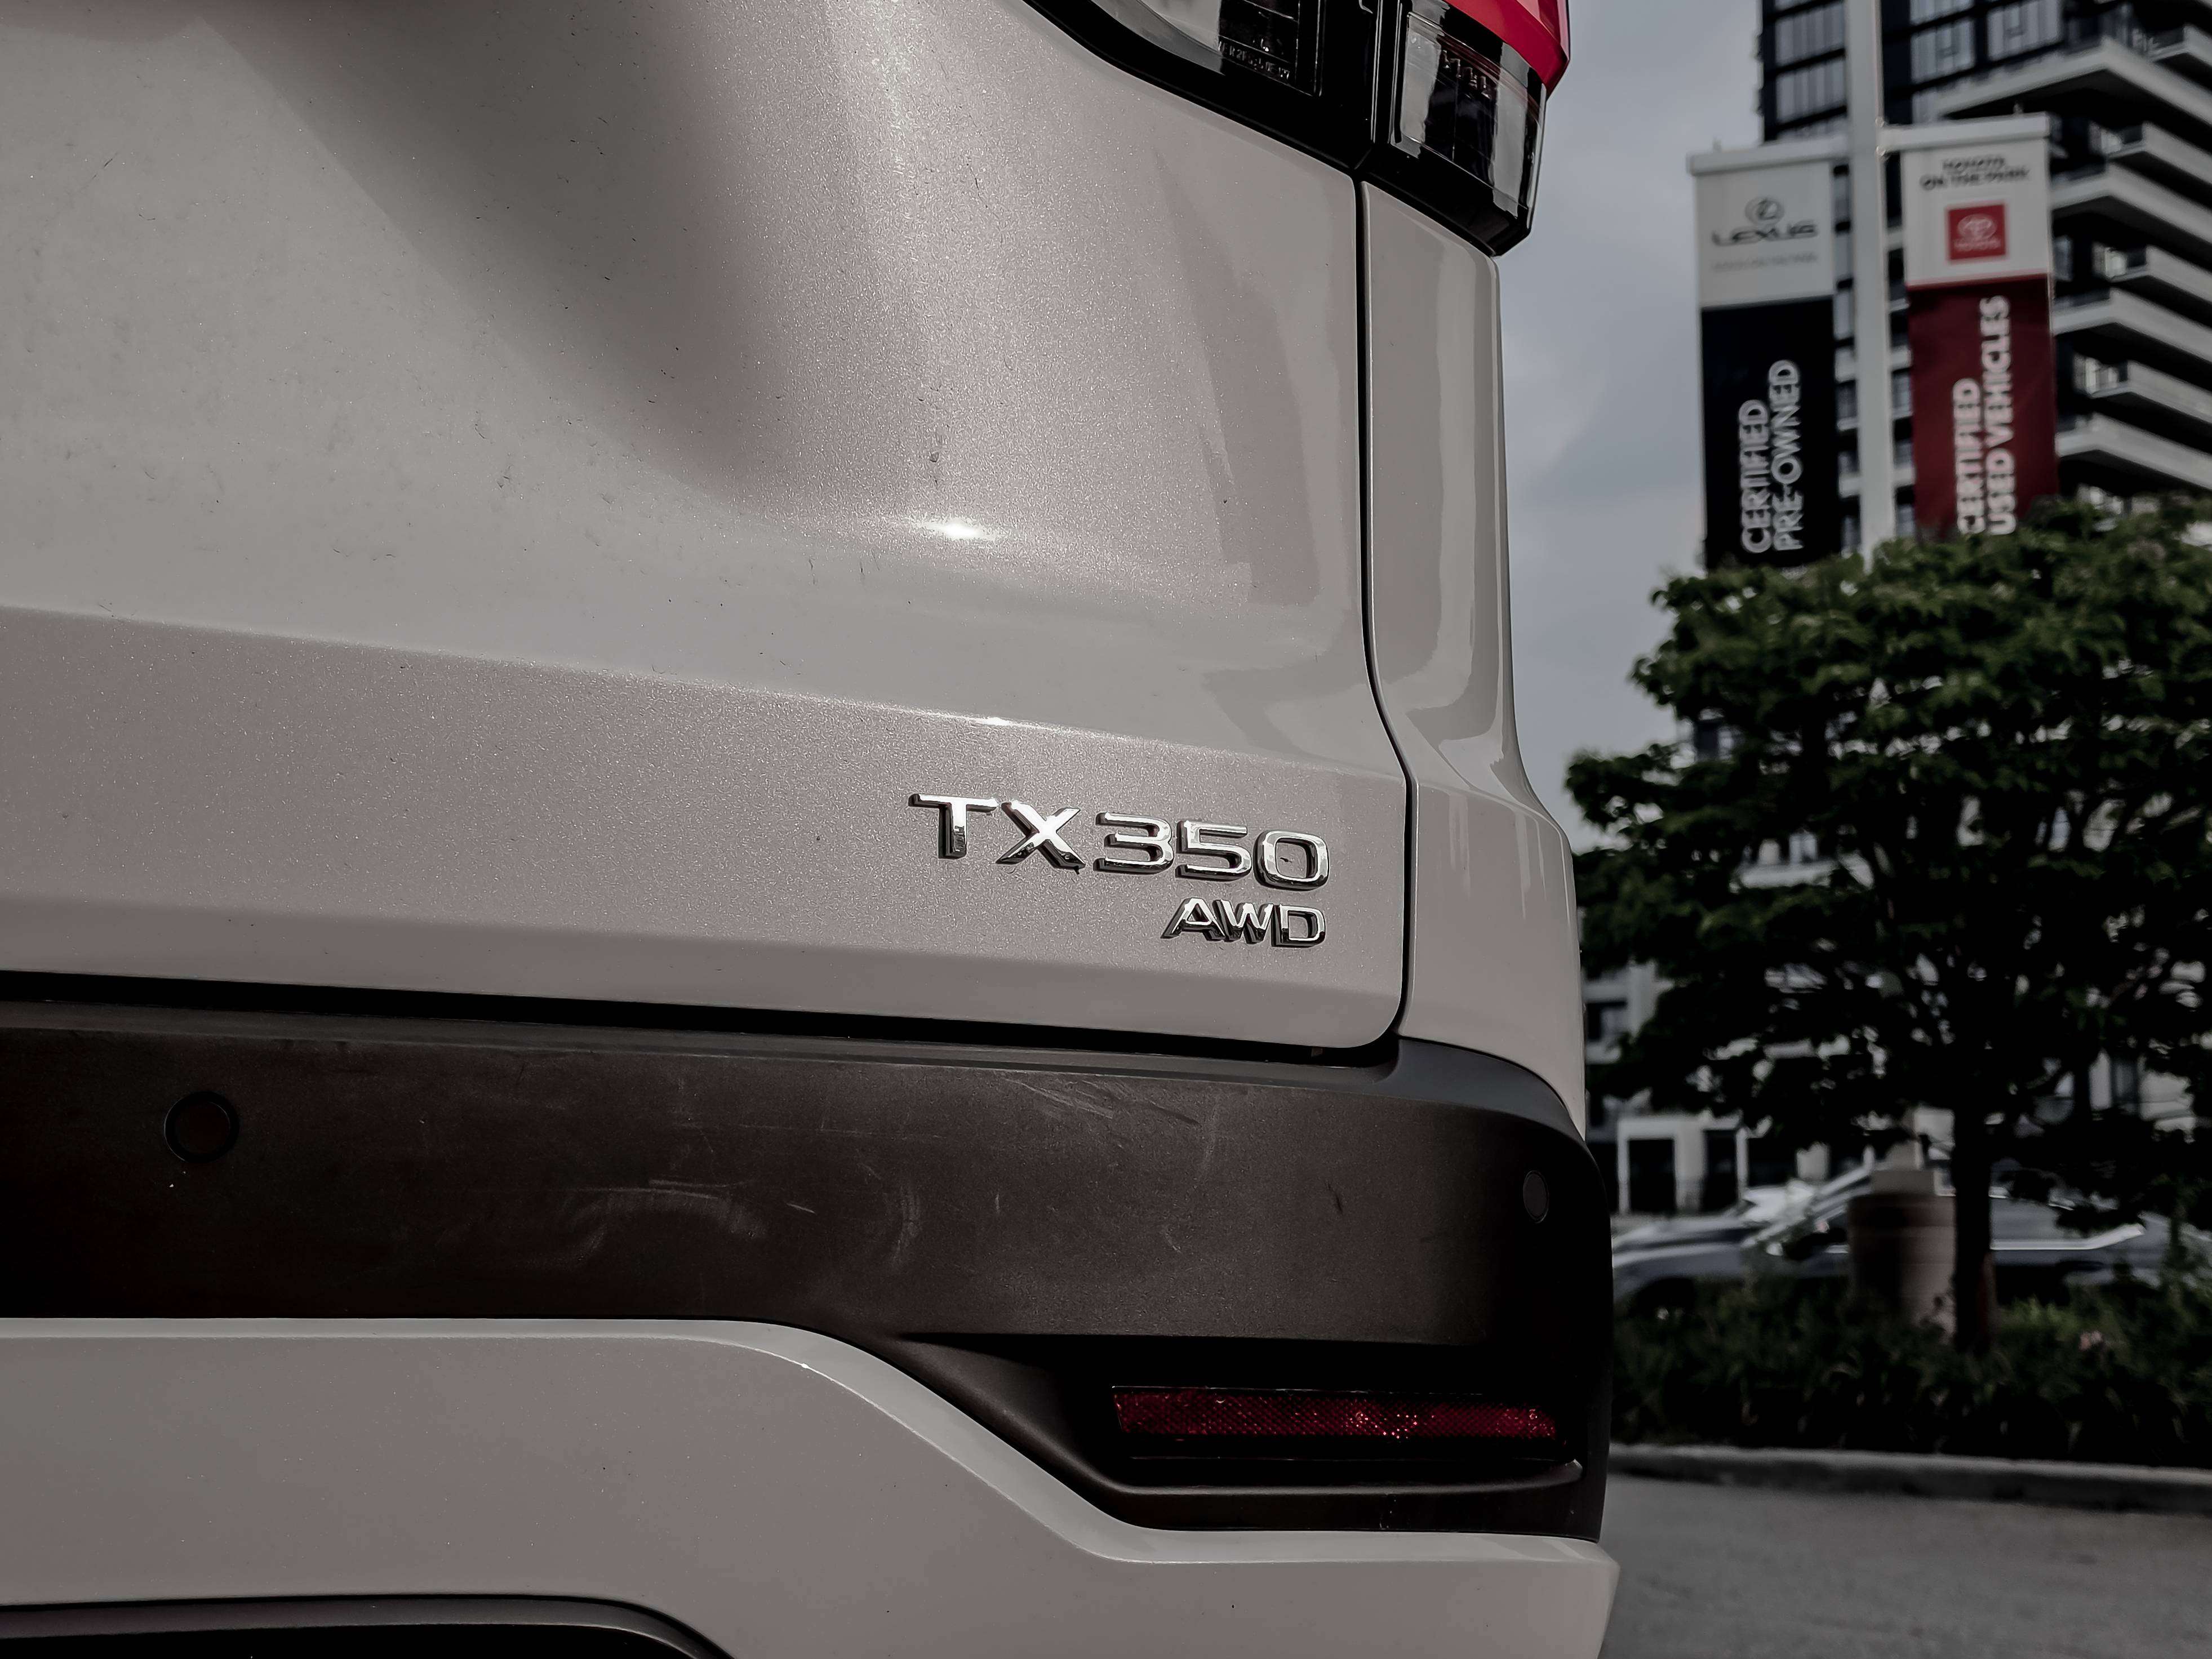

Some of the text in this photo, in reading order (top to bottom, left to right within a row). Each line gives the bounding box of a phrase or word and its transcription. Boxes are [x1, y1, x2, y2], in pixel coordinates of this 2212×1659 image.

[1711, 220, 1819, 246] LEXUS
[1739, 400, 1772, 553] CERTIFIED
[1768, 359, 1804, 551] PRE-OWNED
[1952, 378, 1986, 535] CERTIFIED
[1979, 295, 2017, 535] USED VEHICLES
[1160, 897, 1327, 949] AWD
